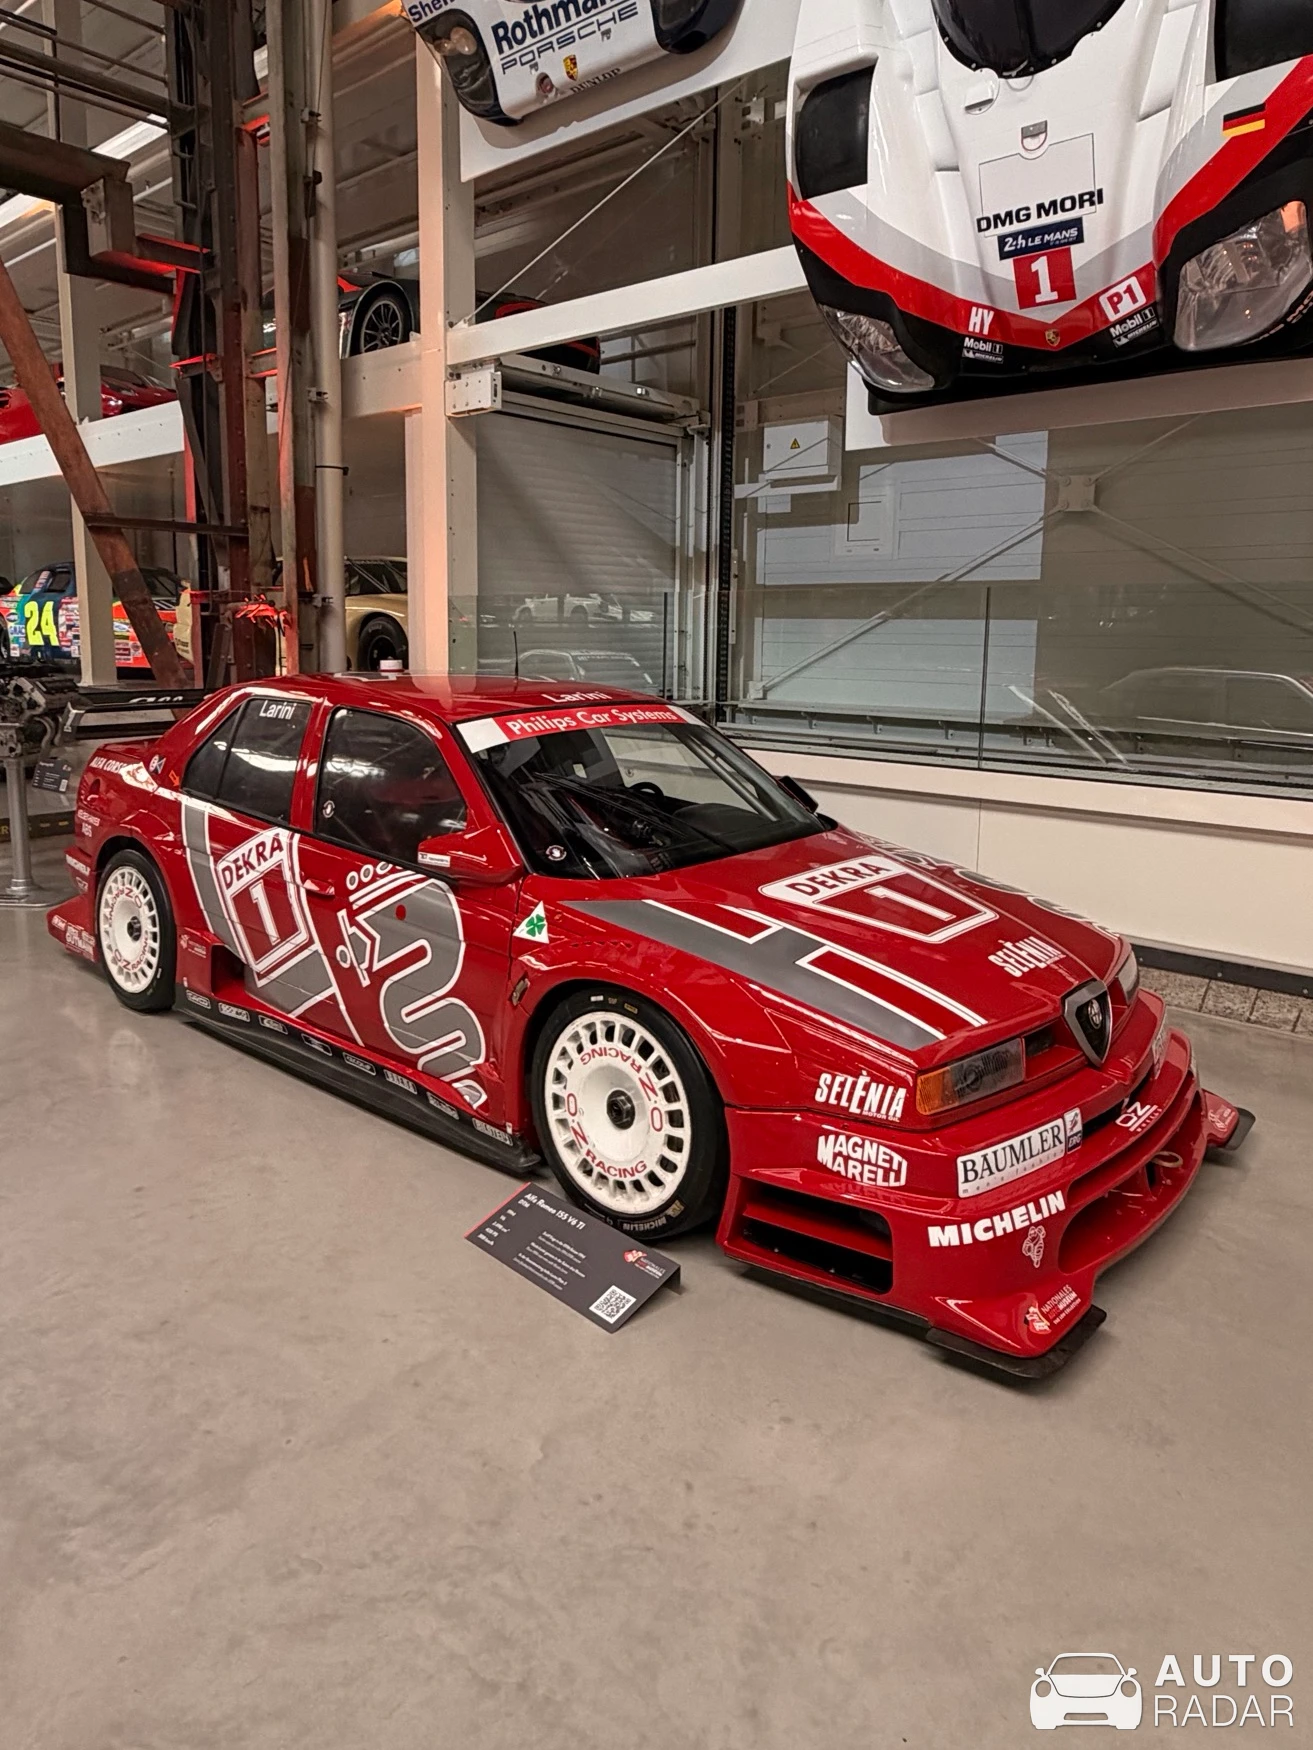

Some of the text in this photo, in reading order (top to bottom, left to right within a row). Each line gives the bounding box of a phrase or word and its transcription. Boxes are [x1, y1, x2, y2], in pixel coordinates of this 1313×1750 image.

[408, 0, 456, 23] She
[491, 0, 611, 55] Rothma
[501, 1, 639, 75] PORSCHE
[570, 67, 621, 94] DUNLOP
[976, 188, 1104, 233] DMG MORI
[1028, 235, 1042, 247] LE
[1043, 227, 1078, 244] MANS
[1031, 255, 1059, 303] 1
[1106, 283, 1139, 315] P1
[968, 306, 995, 336] HY
[1109, 313, 1143, 338] Mobil
[963, 336, 992, 352] Mobil
[24, 601, 60, 646] 24
[259, 699, 297, 720] Larini
[541, 691, 612, 703] Larini
[506, 708, 677, 735] Philips Car Systems
[89, 756, 107, 769] ALFA
[221, 832, 284, 890] DEKRA
[785, 862, 893, 897] DEKRA
[249, 879, 281, 946] 1
[863, 885, 957, 922] 1
[580, 1047, 642, 1075] RACING
[862, 1110, 900, 1123] MOTOR OIL
[585, 1149, 648, 1179] RACING
[817, 1134, 907, 1175] MAGNETI
[817, 1152, 907, 1187] MARELLI
[537, 1199, 556, 1214] Romeo
[927, 1190, 1066, 1248] MICHELIN
[622, 1216, 667, 1232] MICHELIN
[1040, 1284, 1072, 1315] NATIONALES
